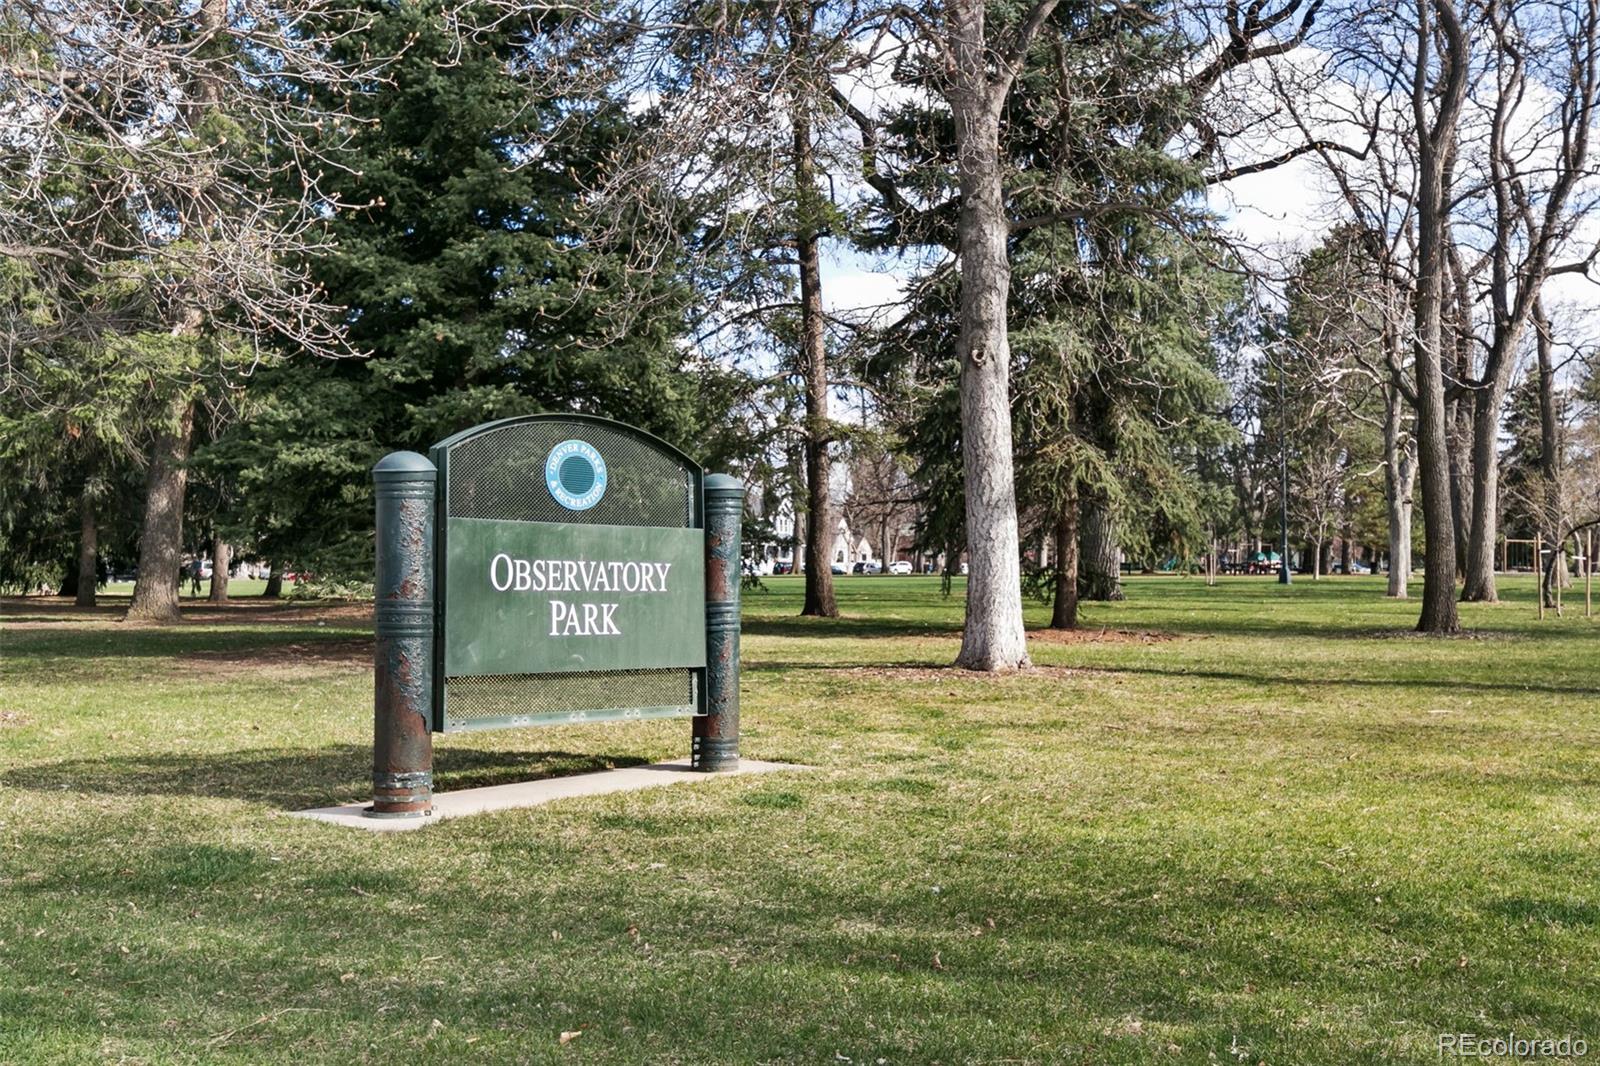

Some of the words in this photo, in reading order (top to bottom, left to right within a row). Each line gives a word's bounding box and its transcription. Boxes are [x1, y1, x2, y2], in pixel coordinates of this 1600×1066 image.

[550, 443, 578, 471] DENVER
[580, 444, 603, 473] PARKS
[555, 482, 603, 507] RECREATION
[490, 553, 671, 592] OBSERVATORY
[549, 600, 621, 636] PARK
